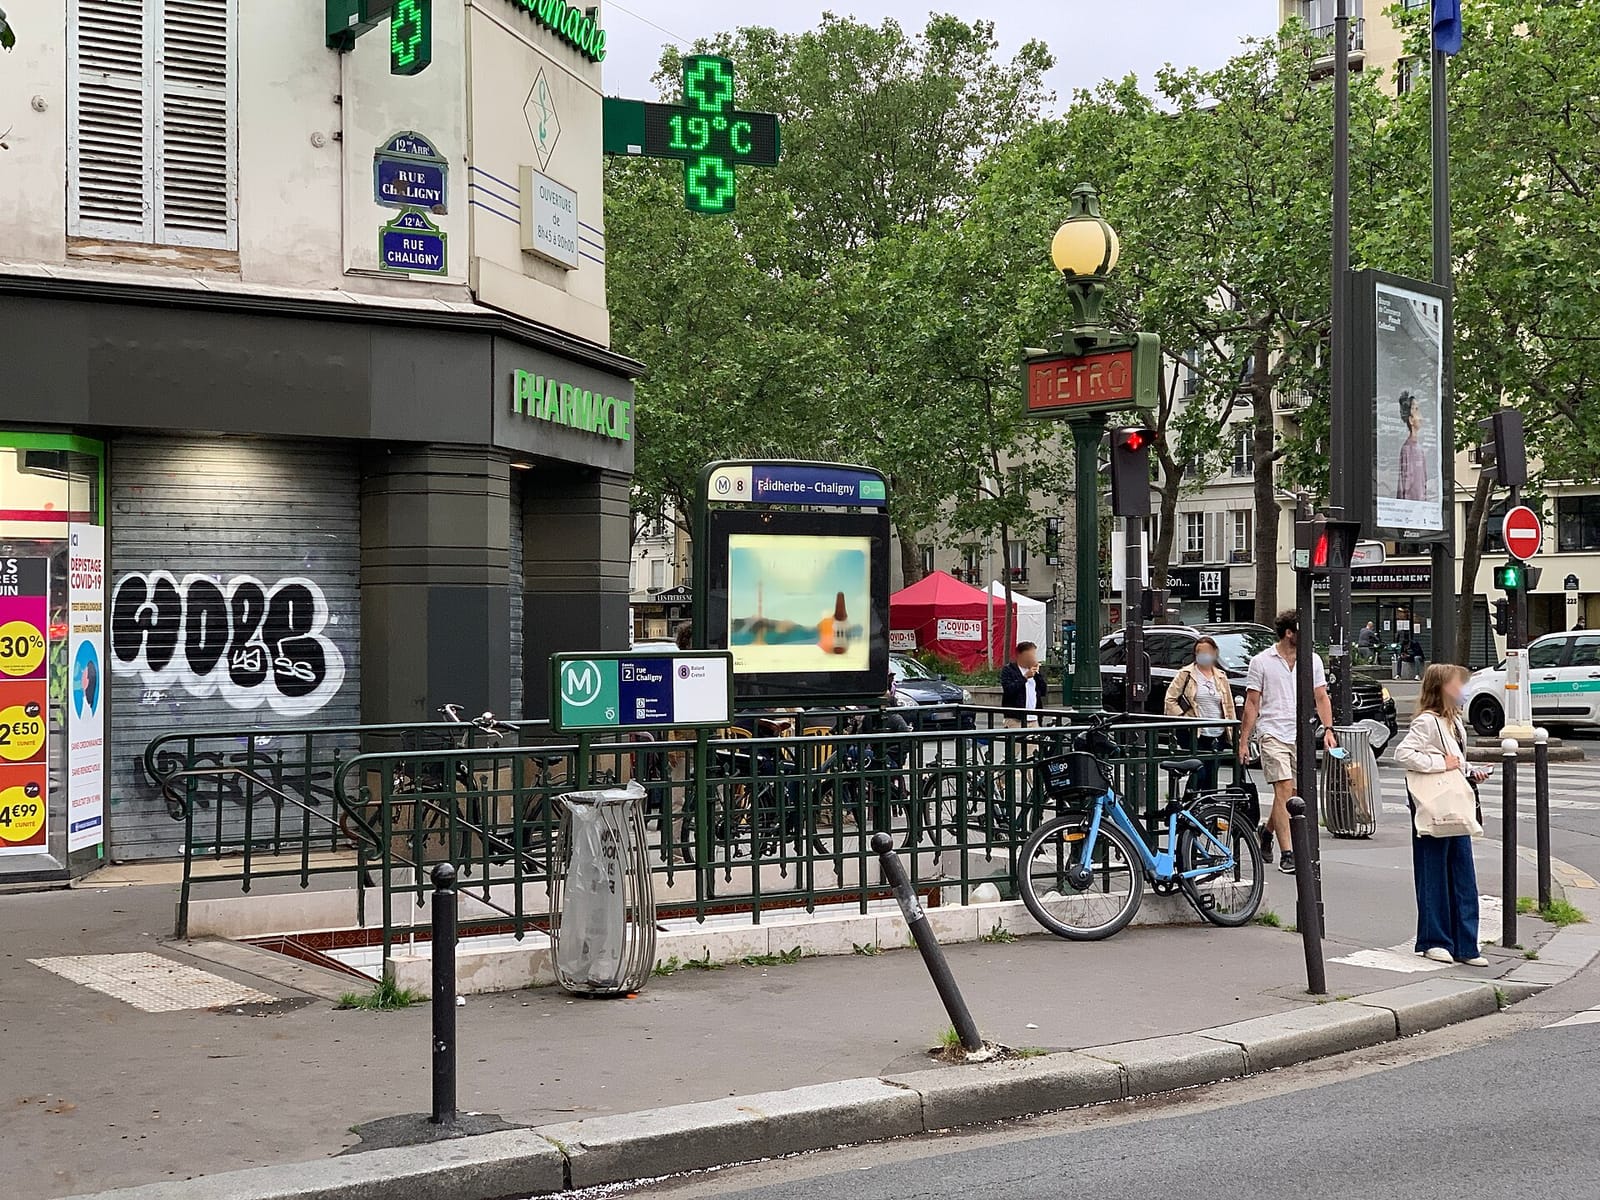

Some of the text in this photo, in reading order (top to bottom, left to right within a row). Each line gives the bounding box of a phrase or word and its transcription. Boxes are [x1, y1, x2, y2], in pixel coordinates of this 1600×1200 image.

[669, 115, 751, 154] 19°C
[399, 170, 426, 184] RUE
[382, 183, 441, 201] CHLIGNY
[540, 185, 572, 214] OUVERTURE
[552, 212, 560, 227] de
[403, 238, 425, 251] RUE
[387, 250, 439, 266] CHALIGNY
[1036, 360, 1127, 401] METRO
[513, 368, 631, 441] PHARMACIE
[737, 480, 744, 491] 8
[814, 482, 855, 496] Chaligny
[0, 558, 18, 574] S
[71, 573, 102, 590] COVID-19
[1201, 573, 1219, 582] BAZ
[1201, 582, 1219, 591] ART
[946, 622, 981, 631] COVID-19
[890, 632, 915, 641] OVID-19
[625, 670, 663, 682] 2 Chaligny
[681, 668, 687, 678] 8
[568, 668, 592, 695] M
